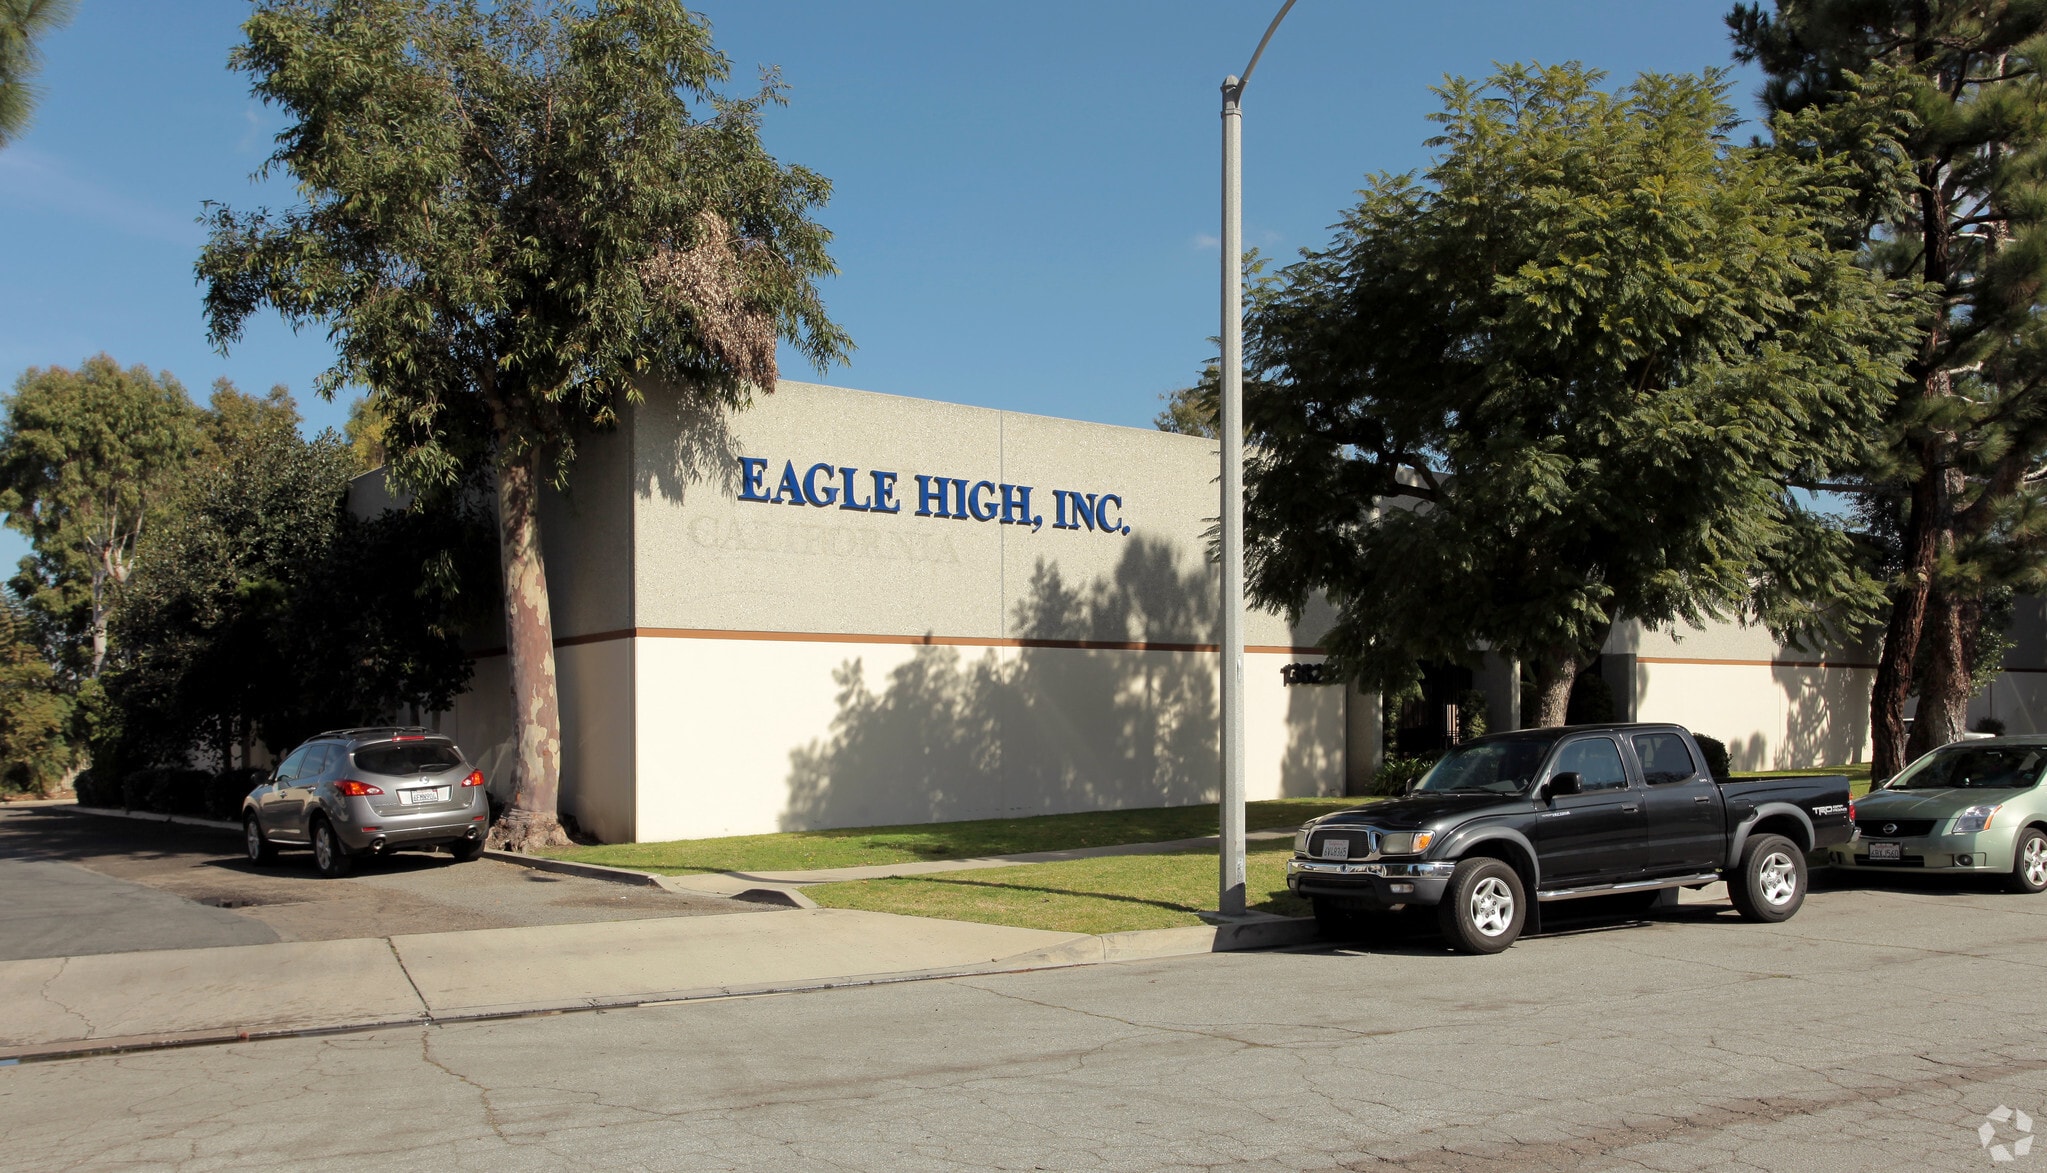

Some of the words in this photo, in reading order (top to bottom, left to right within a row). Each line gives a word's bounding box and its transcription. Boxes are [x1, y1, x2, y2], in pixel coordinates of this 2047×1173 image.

[737, 456, 900, 514] EAGLE
[914, 474, 1043, 534] HIGH,
[1052, 489, 1132, 536] INC.
